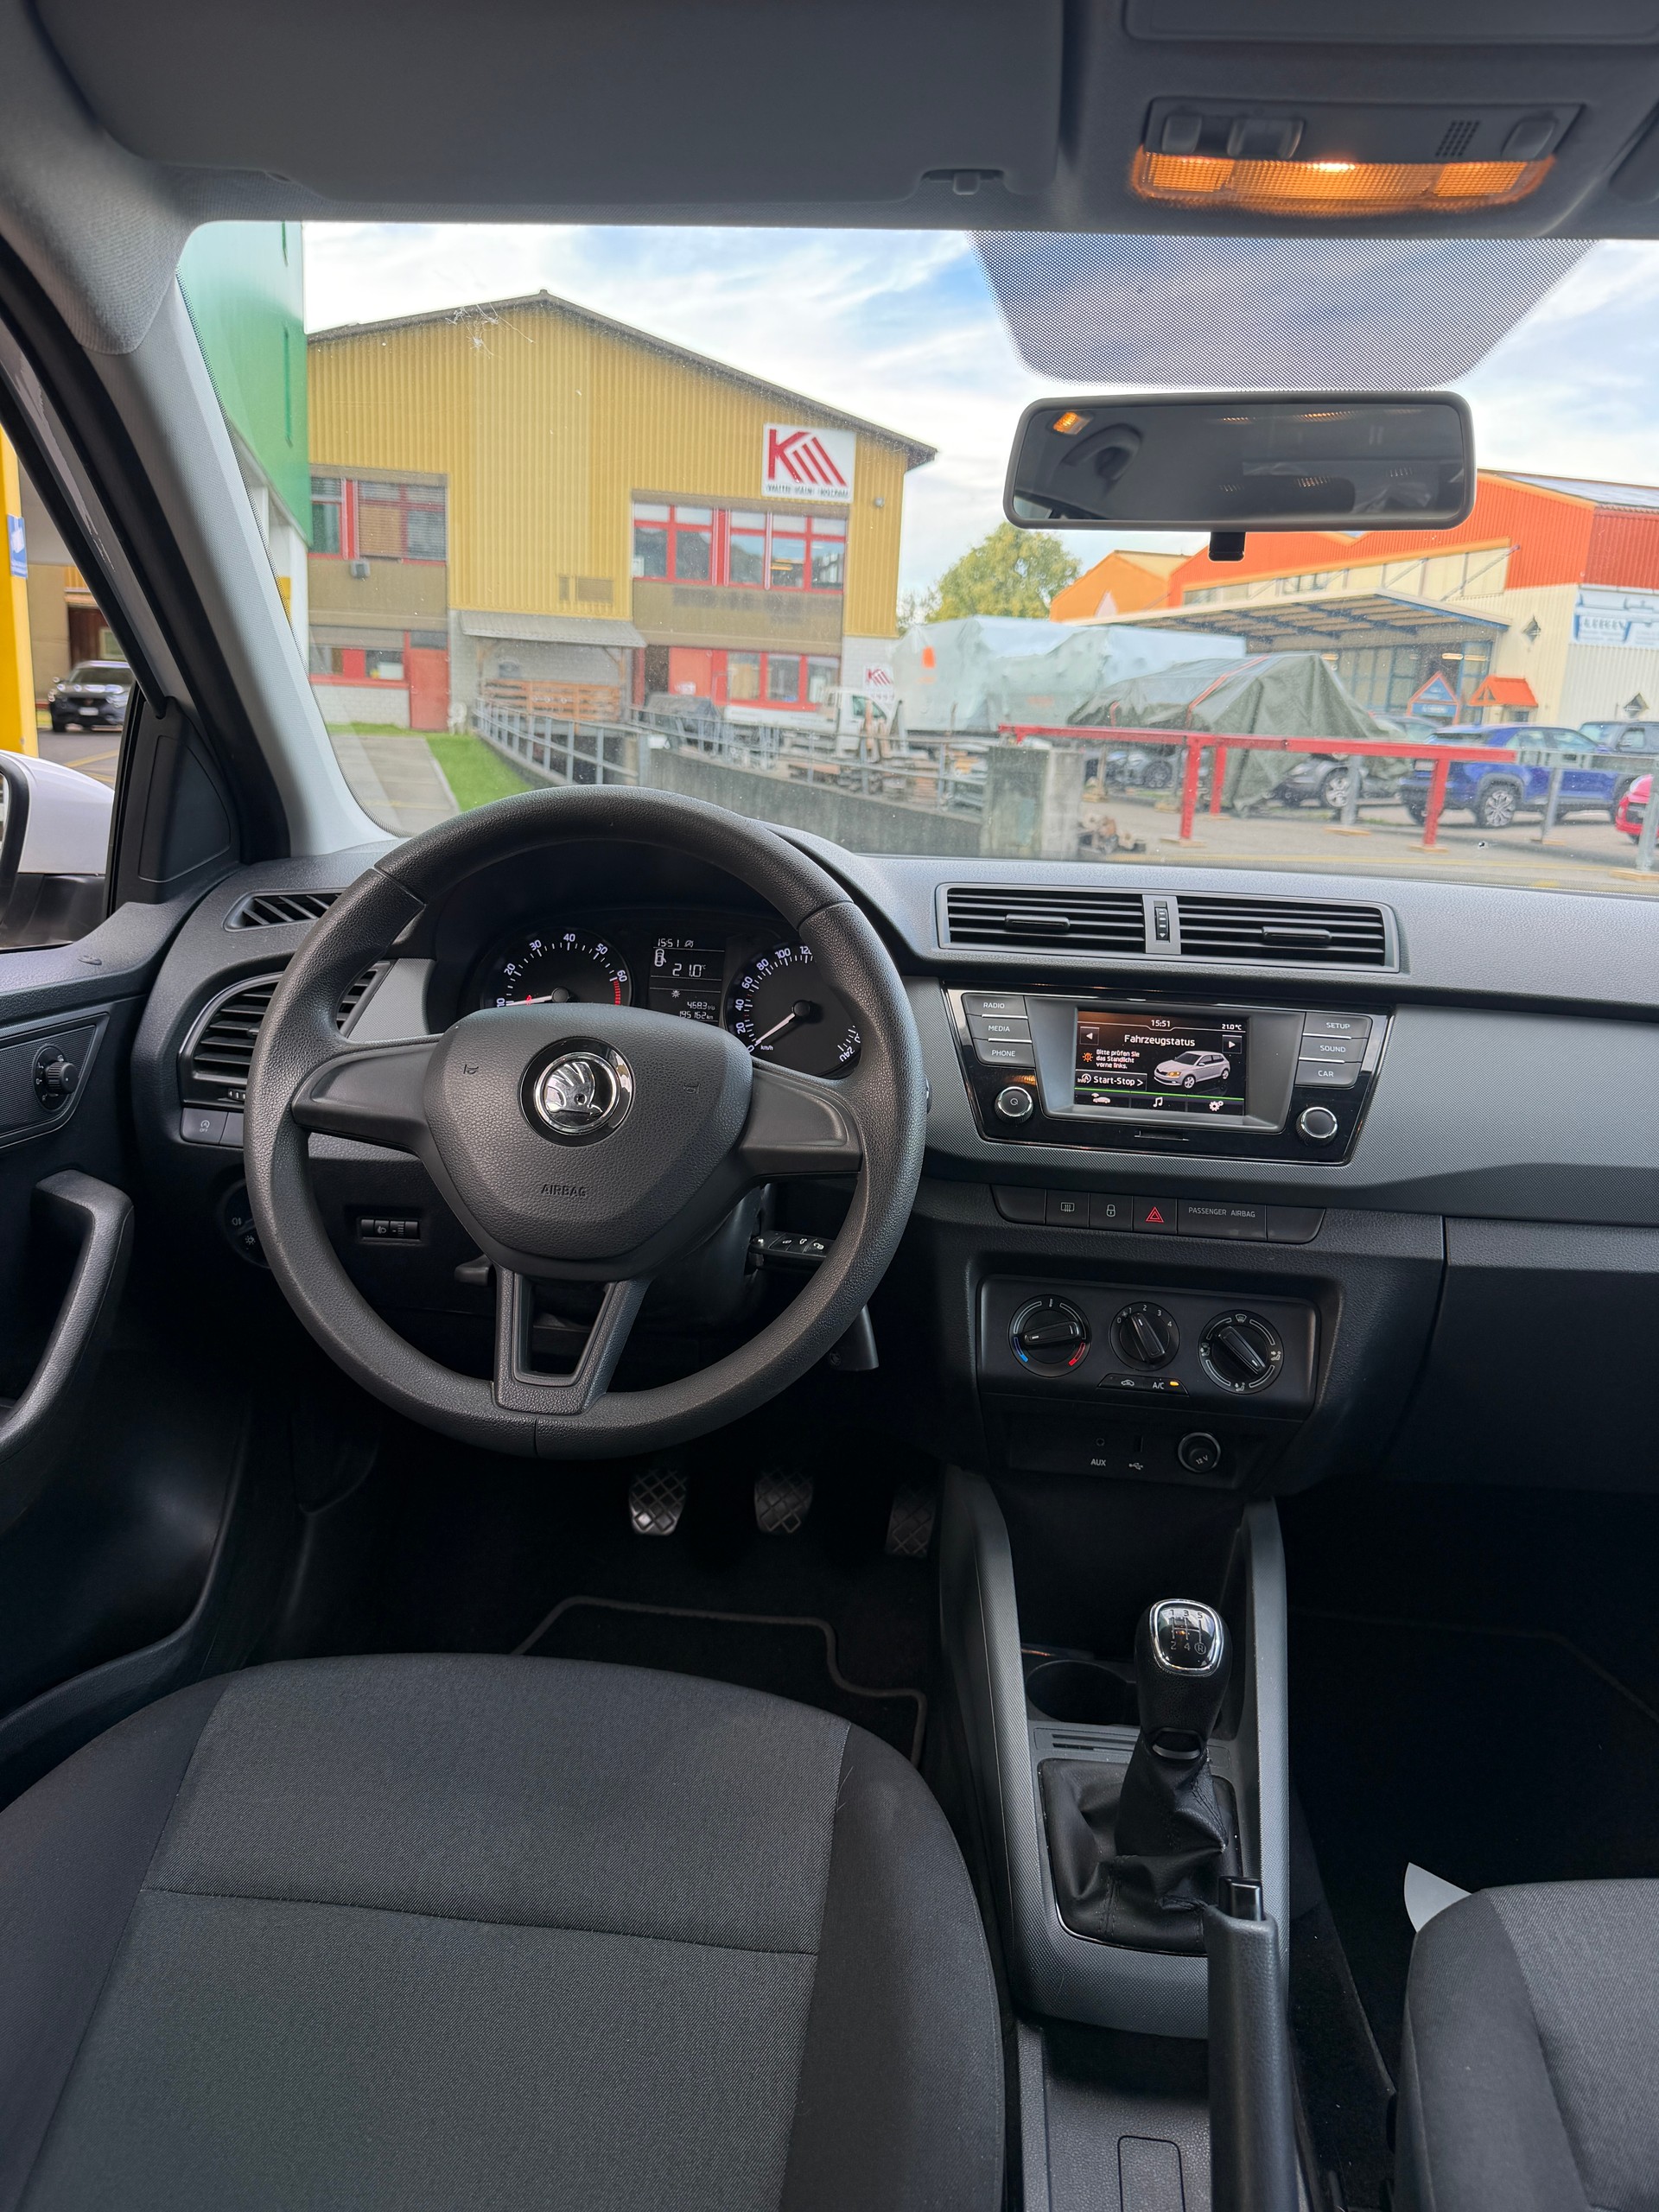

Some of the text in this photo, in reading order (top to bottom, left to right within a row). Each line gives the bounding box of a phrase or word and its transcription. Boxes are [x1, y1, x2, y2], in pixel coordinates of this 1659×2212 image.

[563, 933, 575, 942] 40
[658, 938, 679, 947] 15:51
[529, 939, 542, 951] 30
[595, 943, 608, 955] 50
[799, 945, 812, 956] 12
[775, 948, 791, 959] 100
[504, 963, 516, 976] 20
[756, 958, 769, 970] 80
[616, 969, 628, 982] 60
[741, 976, 753, 989] 60
[734, 999, 744, 1011] 40
[735, 1022, 747, 1034] 20
[1124, 1034, 1196, 1046] Fahrzeugstatus
[1093, 1075, 1135, 1086] Start-Stop
[541, 1184, 586, 1197] AIRBAG
[1188, 1207, 1227, 1216] PASSENGER
[1170, 1641, 1176, 1649] 2
